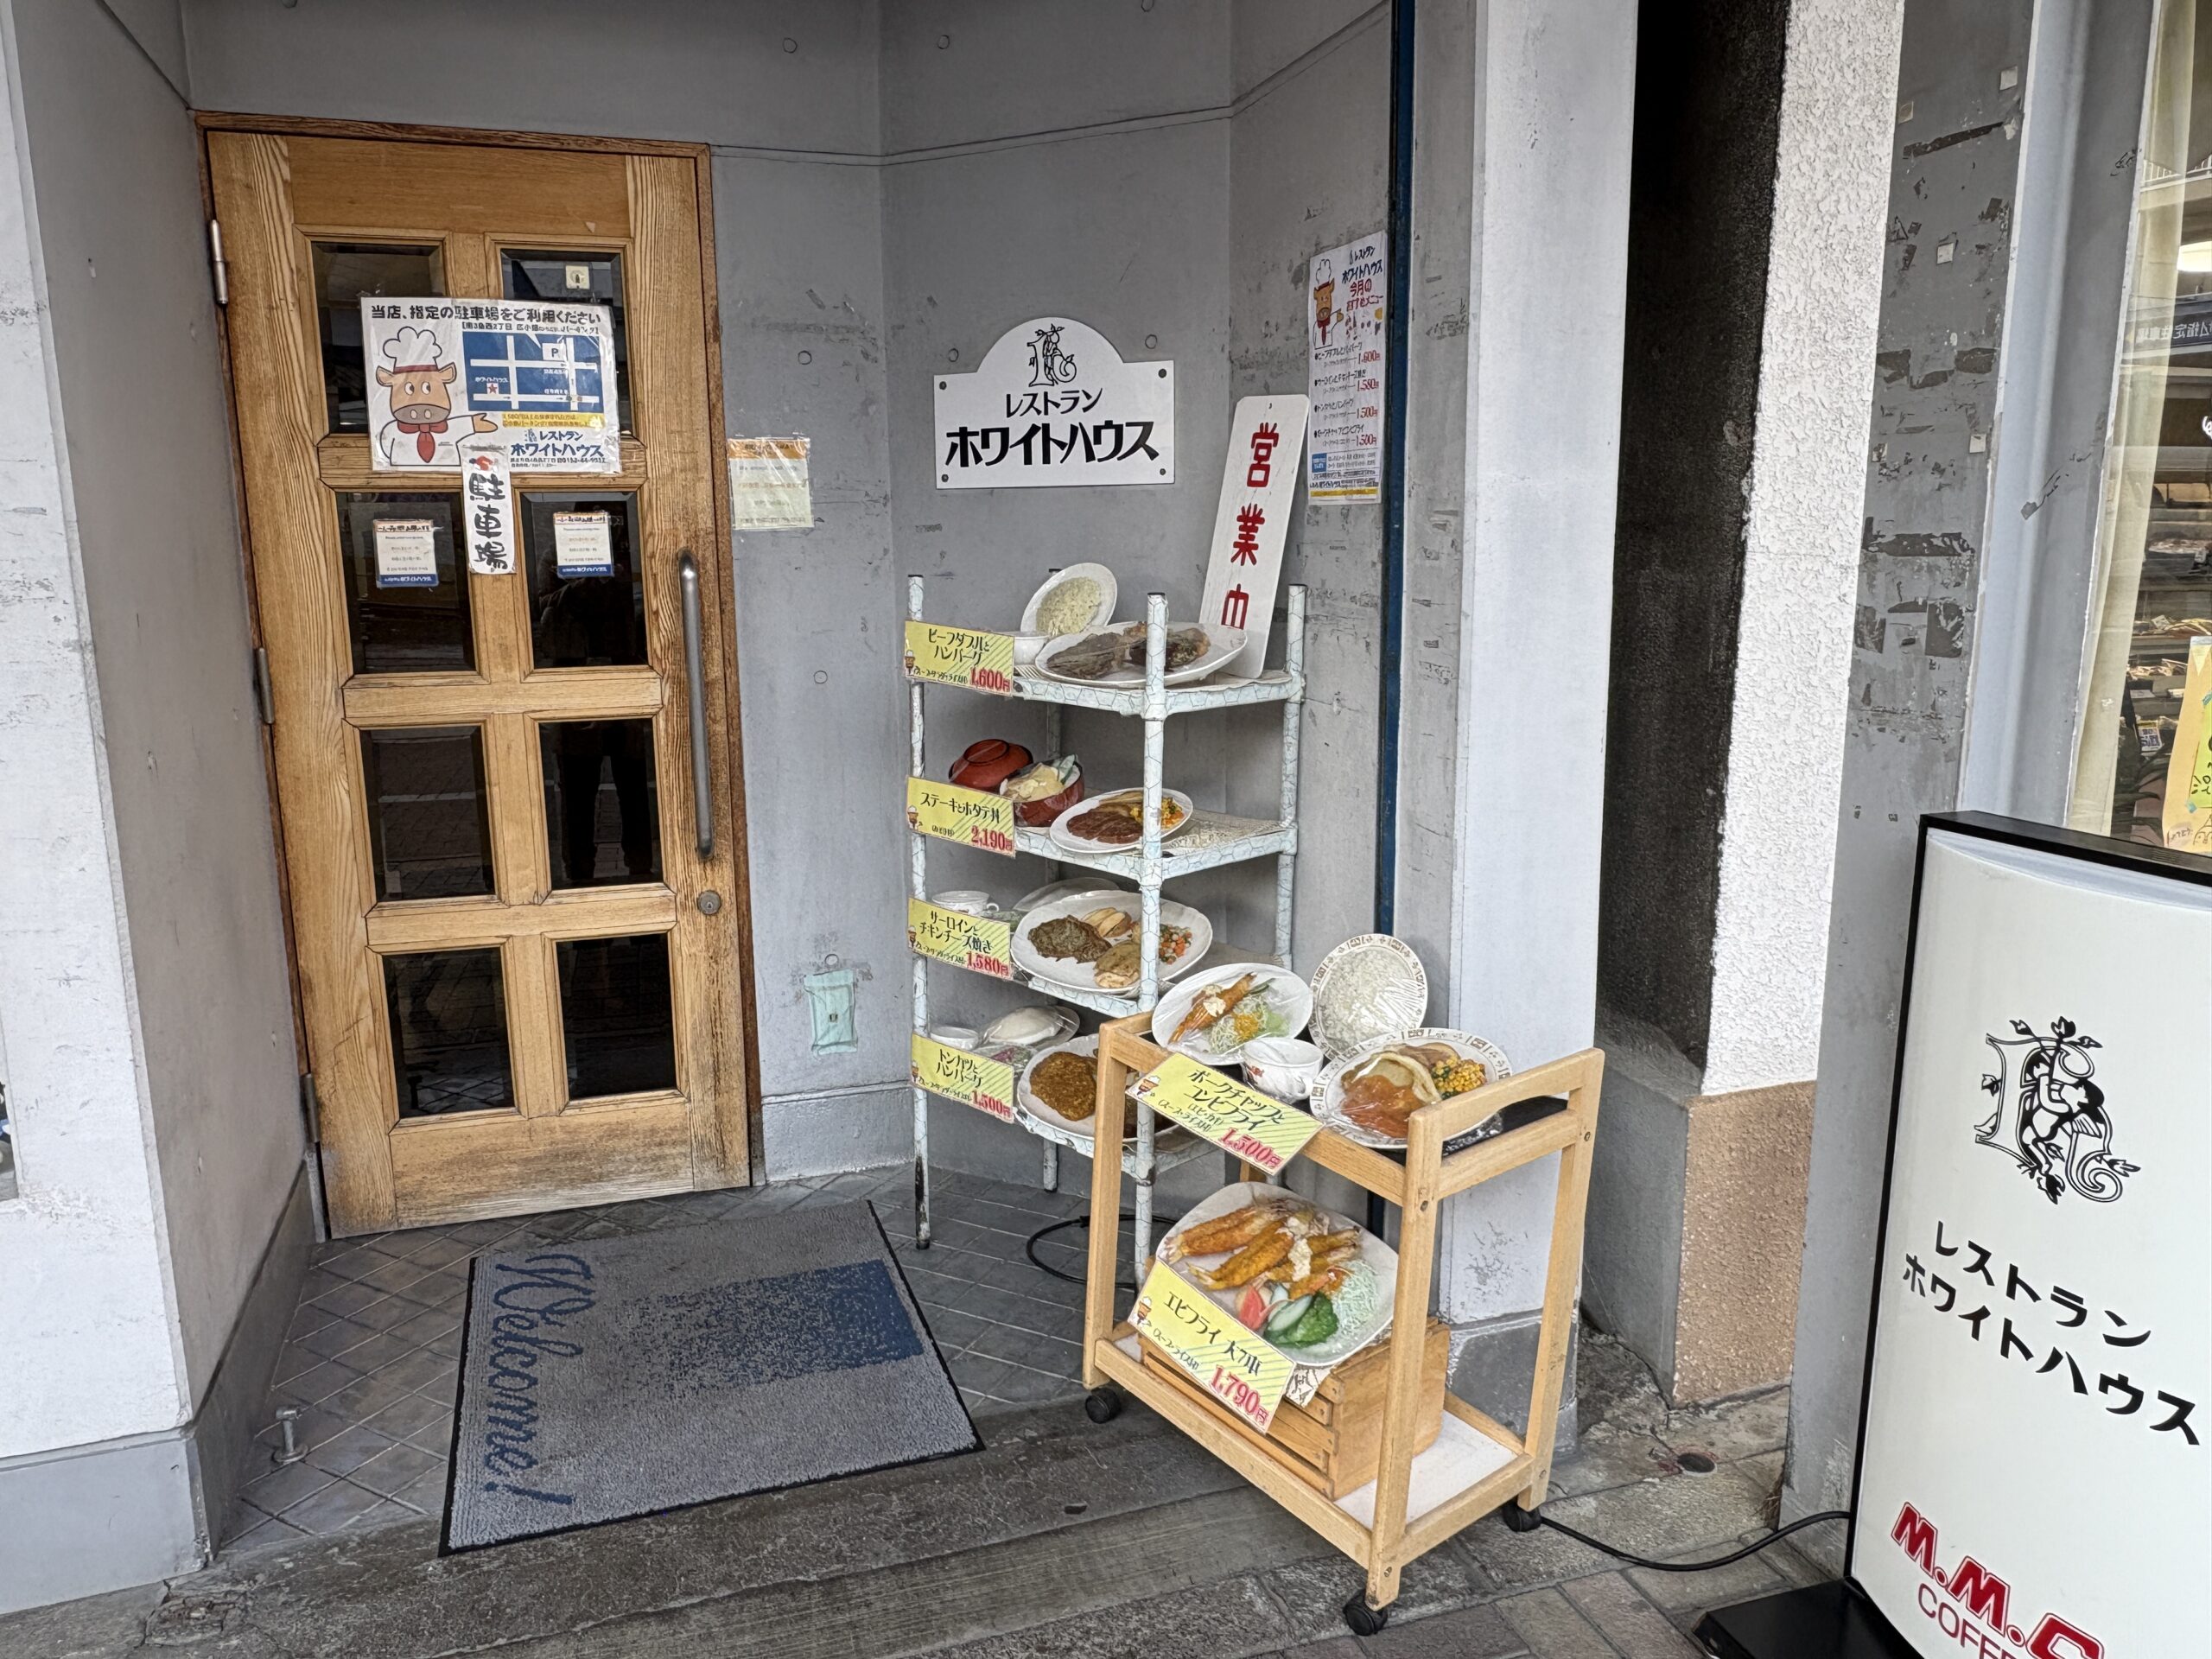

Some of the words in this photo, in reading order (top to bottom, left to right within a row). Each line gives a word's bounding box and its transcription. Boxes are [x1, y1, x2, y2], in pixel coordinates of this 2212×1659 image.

[1342, 258, 1382, 283] ホワイトハウス
[372, 304, 601, 324] 当店、指定の駐車場をご利用ください
[550, 347, 559, 358] P
[1006, 388, 1103, 418] レストラン
[511, 442, 605, 457] ホワイトハウス
[539, 430, 583, 442] レストラン
[945, 420, 1160, 467] ホワイトハウス
[468, 472, 510, 573] 駐車場
[931, 910, 979, 936] サーロインと
[1187, 1068, 1286, 1125] ポークチャップと
[1936, 1220, 2152, 1348] レストラン
[1163, 1291, 1222, 1344] エビフライ
[1903, 1253, 2200, 1446] ホワイトハウス
